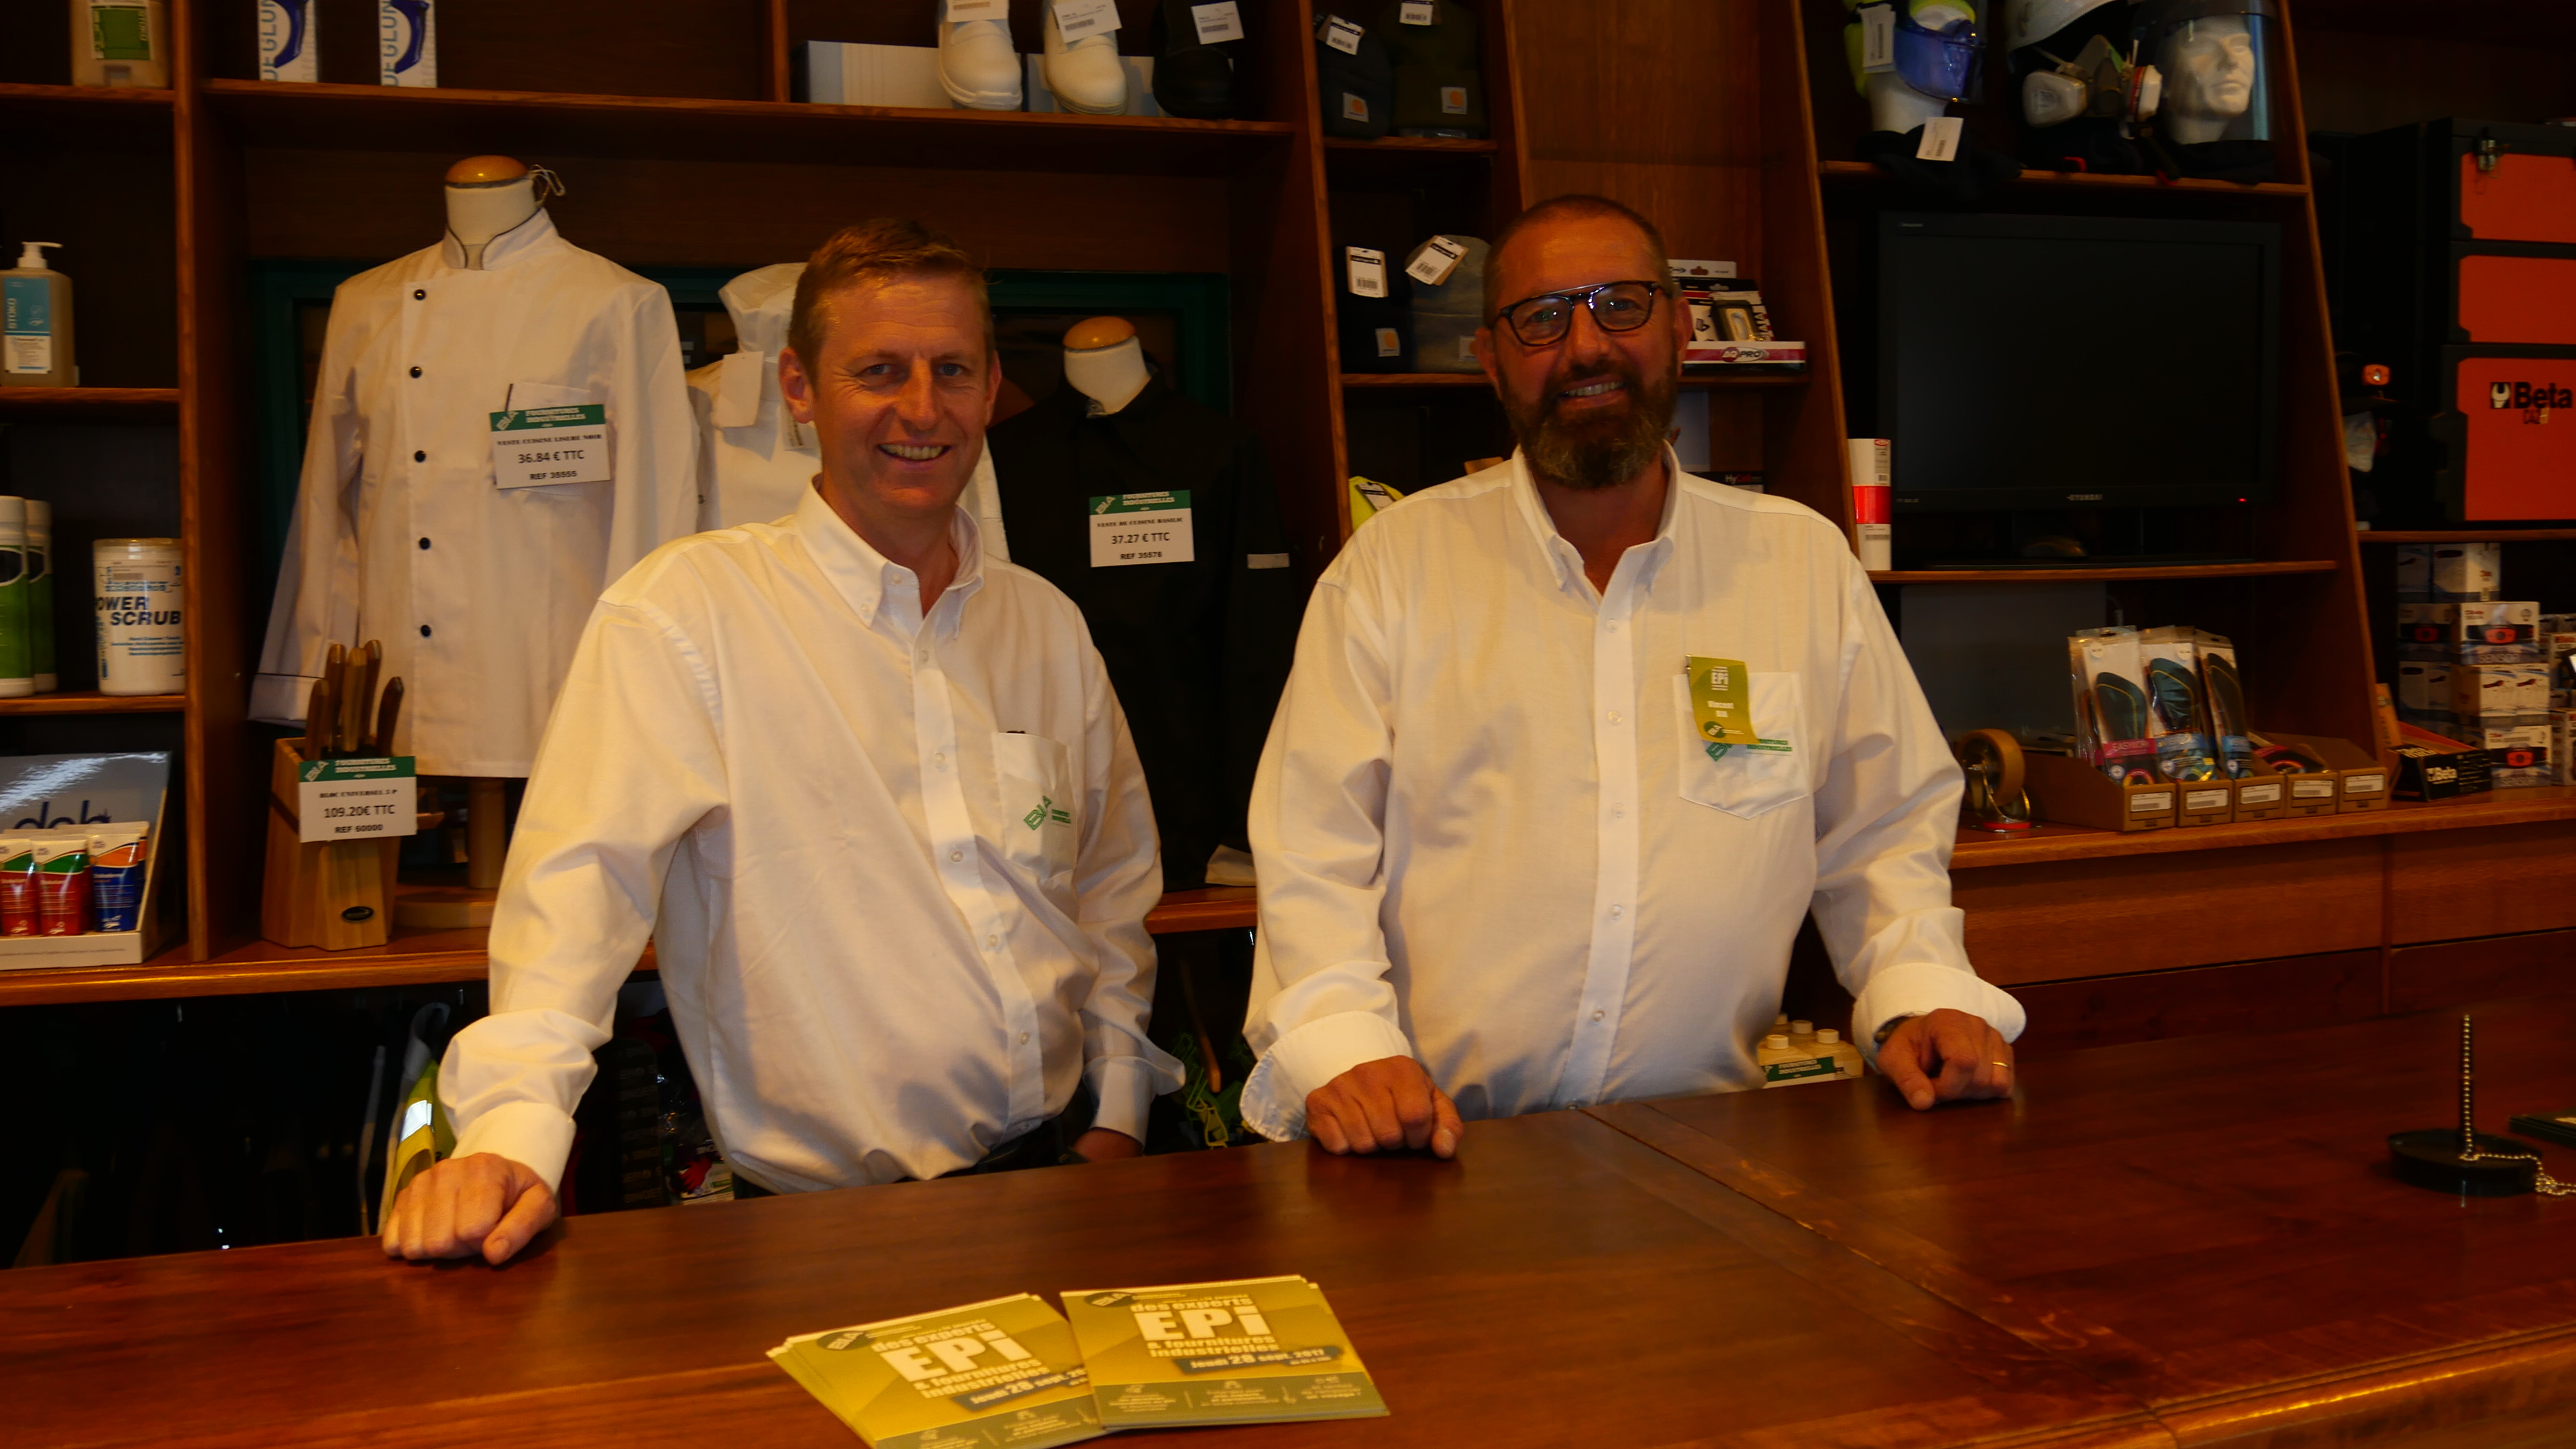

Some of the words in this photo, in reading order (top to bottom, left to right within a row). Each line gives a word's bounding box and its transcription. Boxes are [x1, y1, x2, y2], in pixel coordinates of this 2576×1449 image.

[2514, 382, 2572, 409] Beta
[518, 451, 550, 464] 36.84
[553, 451, 561, 461] €
[563, 450, 585, 460] TTC
[1111, 534, 1139, 544] 37.27
[1142, 533, 1149, 542] €
[1151, 532, 1170, 541] TTC
[94, 596, 148, 611] OWER
[110, 611, 182, 625] SCRUB
[323, 805, 370, 818] 109.20€
[373, 804, 396, 814] TTC
[1024, 796, 1052, 830] BIA
[335, 825, 354, 833] REF
[1130, 1303, 1170, 1312] des
[1172, 1297, 1254, 1310] experts
[1134, 1305, 1271, 1341] EPi
[871, 1339, 914, 1353] des
[913, 1322, 997, 1344] experts
[1163, 1336, 1276, 1348] fournitures
[880, 1330, 1033, 1383] EPi
[930, 1358, 1042, 1387] fournitures
